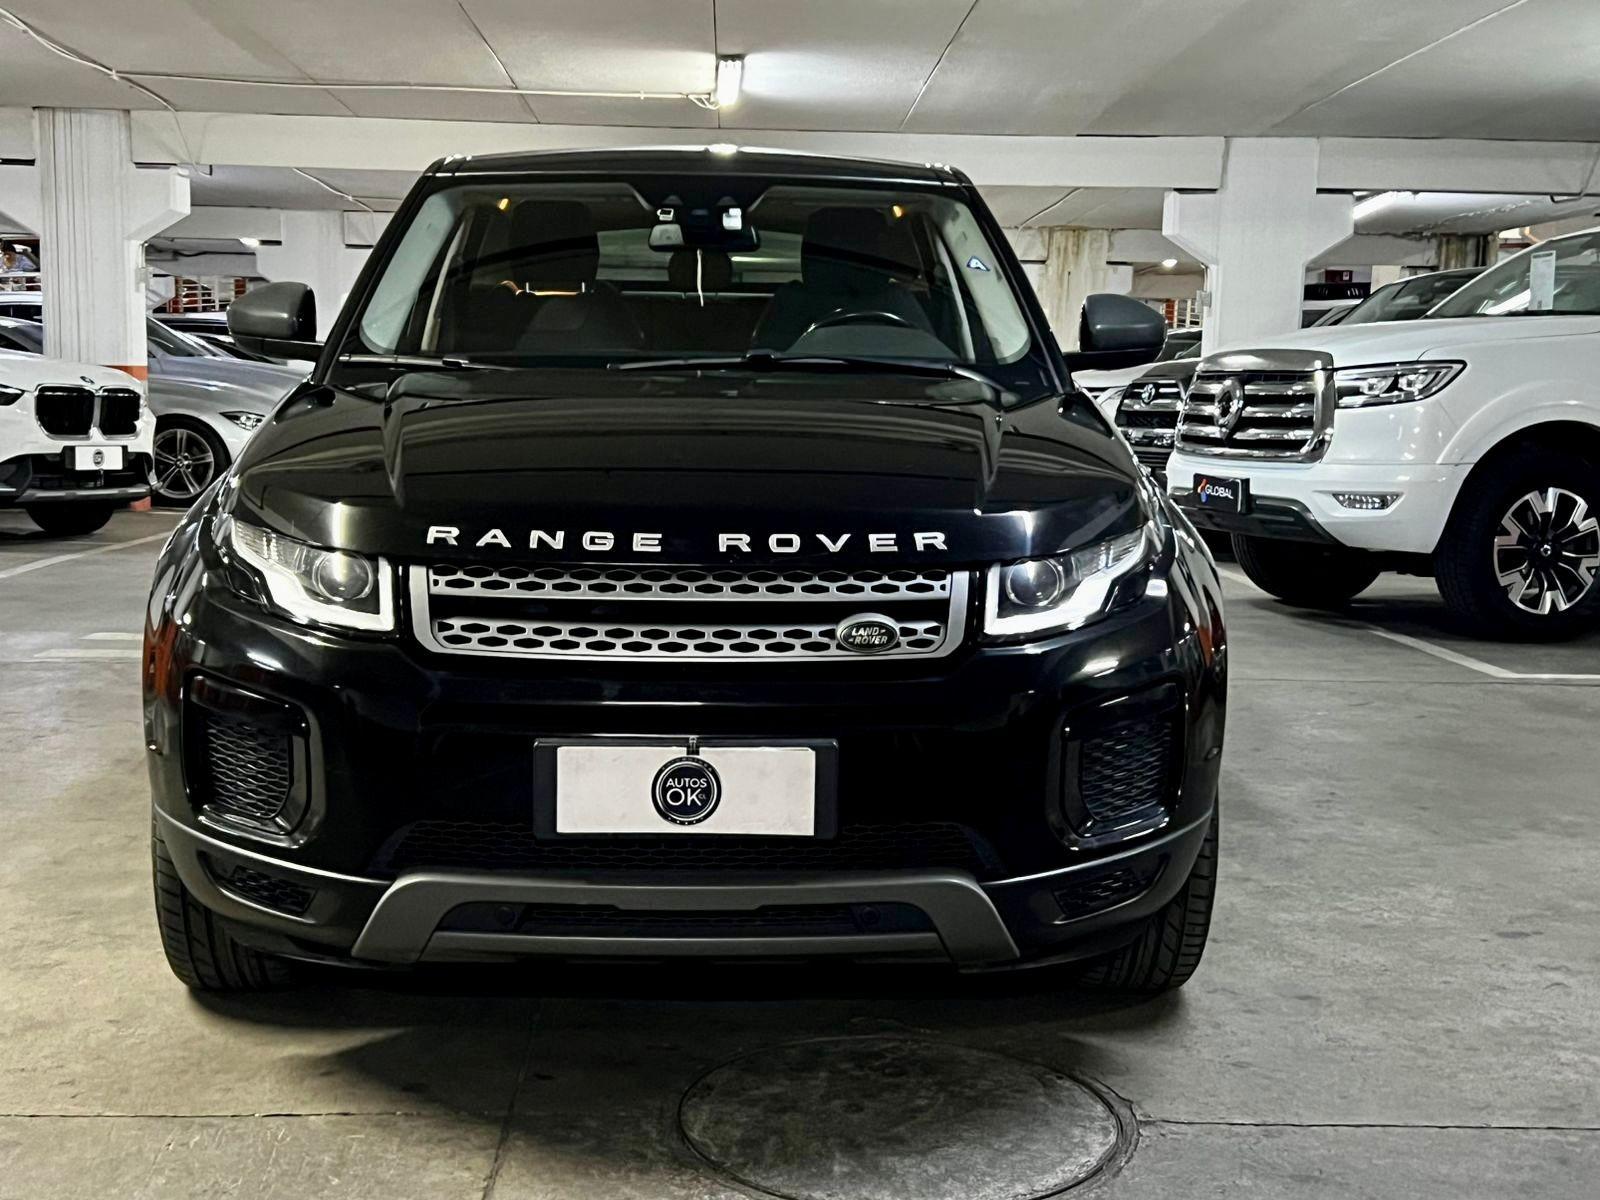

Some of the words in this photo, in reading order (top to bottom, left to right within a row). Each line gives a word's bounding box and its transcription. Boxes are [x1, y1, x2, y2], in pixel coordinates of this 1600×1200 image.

[1205, 484, 1234, 499] GLOBAL
[426, 525, 663, 553] RANGE
[718, 531, 949, 553] ROVER
[851, 626, 880, 636] LAND
[854, 635, 888, 645] ROVER
[665, 778, 707, 788] AUTOS
[666, 787, 702, 807] OK
